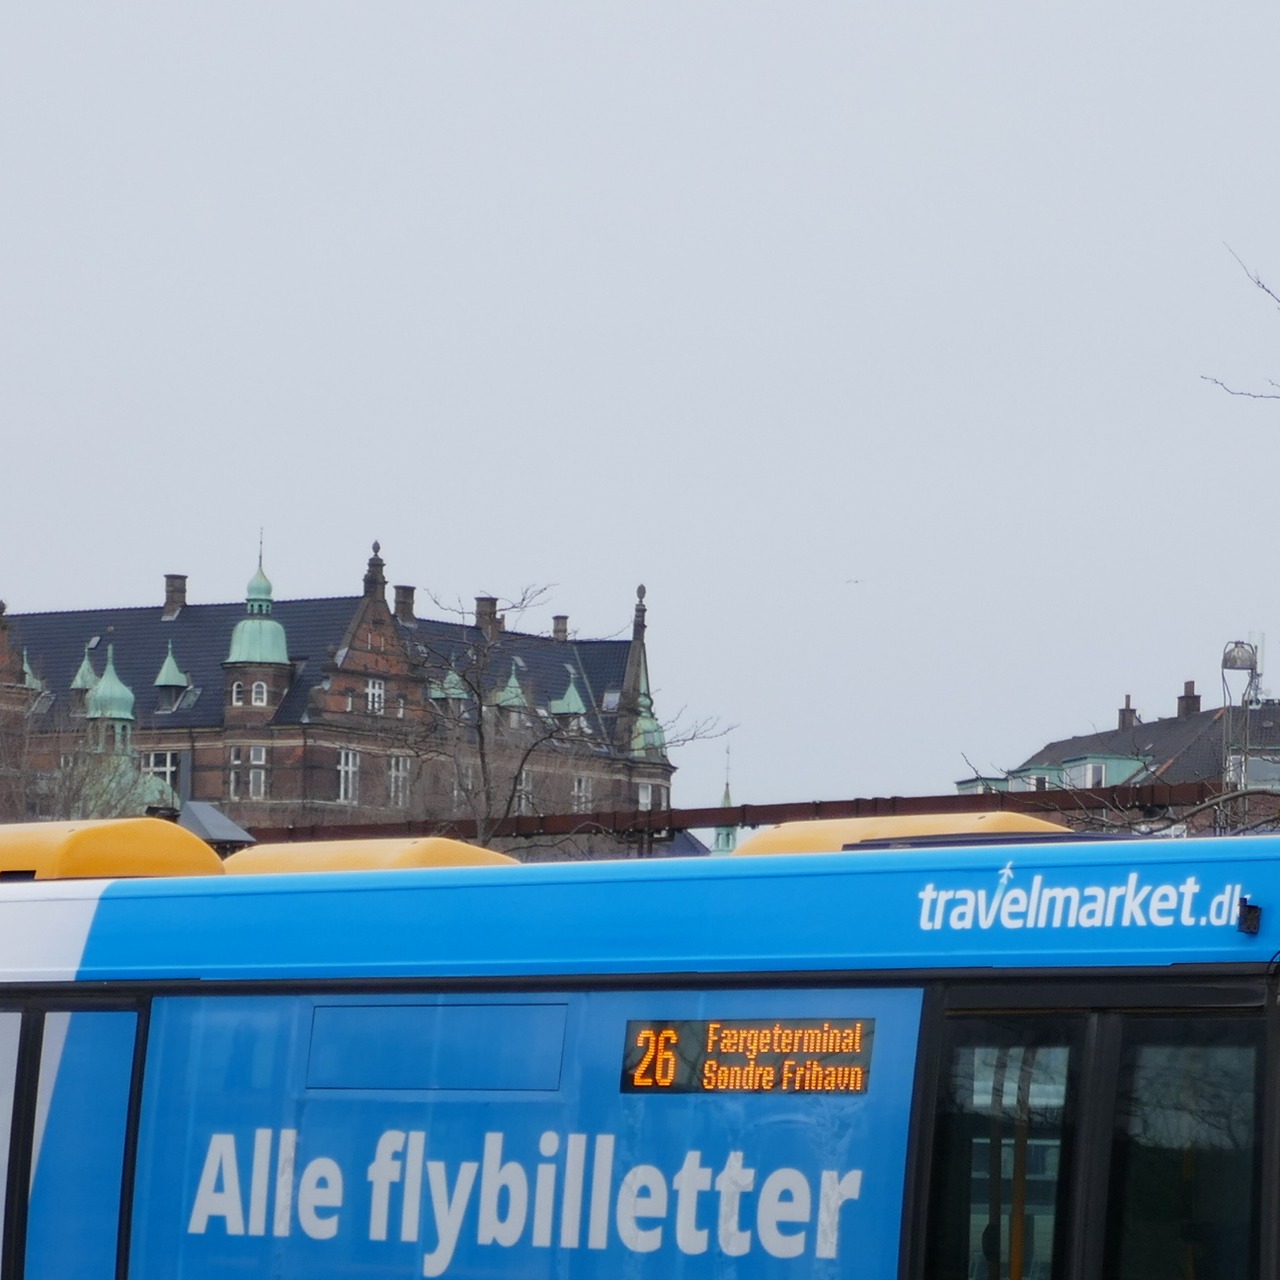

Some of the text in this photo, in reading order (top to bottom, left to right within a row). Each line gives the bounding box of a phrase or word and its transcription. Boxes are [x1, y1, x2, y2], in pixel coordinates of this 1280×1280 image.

[633, 1029, 679, 1087] 26
[706, 1023, 862, 1060] Færgeterminal
[781, 1060, 862, 1091] Frihavn
[187, 1128, 863, 1279] Alle flybilletter
